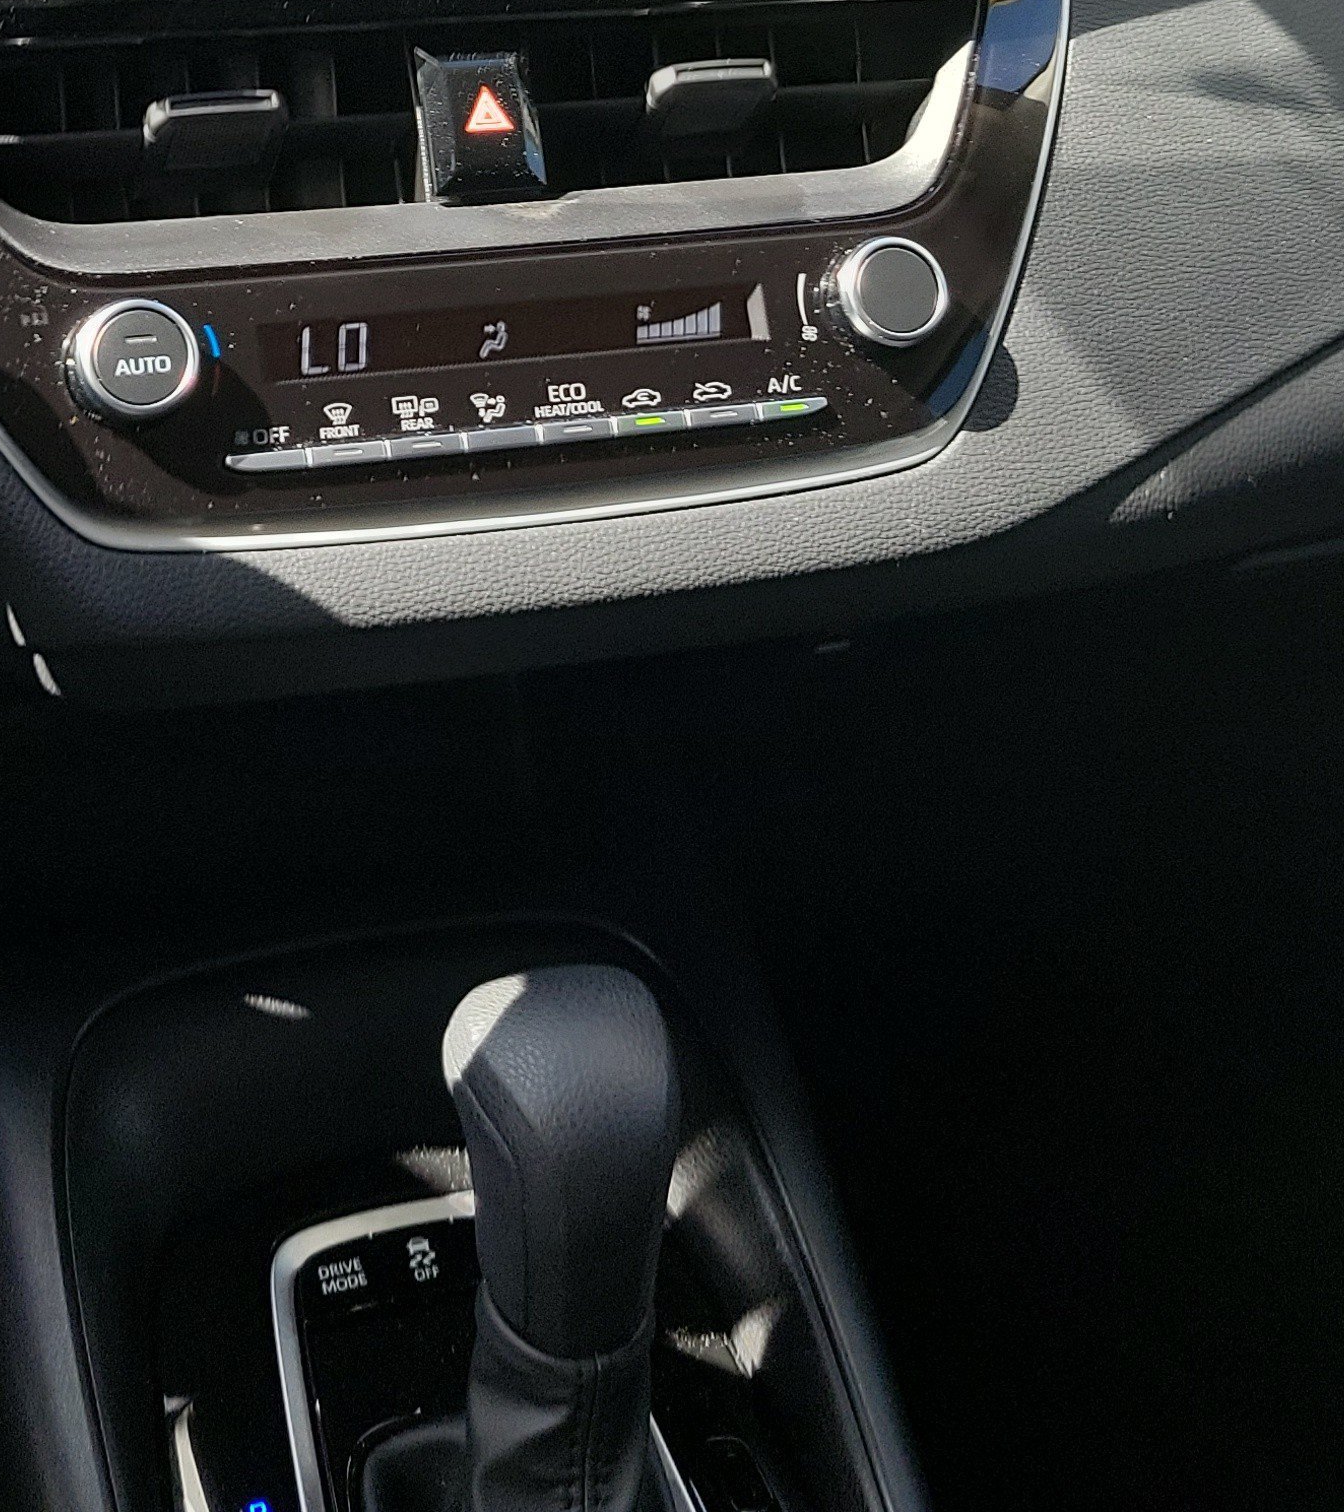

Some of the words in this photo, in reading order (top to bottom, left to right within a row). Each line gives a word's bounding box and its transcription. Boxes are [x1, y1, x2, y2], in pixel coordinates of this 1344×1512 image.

[301, 322, 368, 375] LO
[114, 354, 172, 377] AUTO
[547, 383, 587, 403] ECO
[767, 375, 802, 394] A/C
[534, 400, 605, 419] HEAT/COOL
[319, 424, 361, 439] FRONT
[400, 417, 435, 432] REAR
[253, 425, 291, 445] OFF
[318, 1256, 362, 1280] DRIVE
[414, 1264, 439, 1282] OFF
[322, 1270, 368, 1295] MODE
